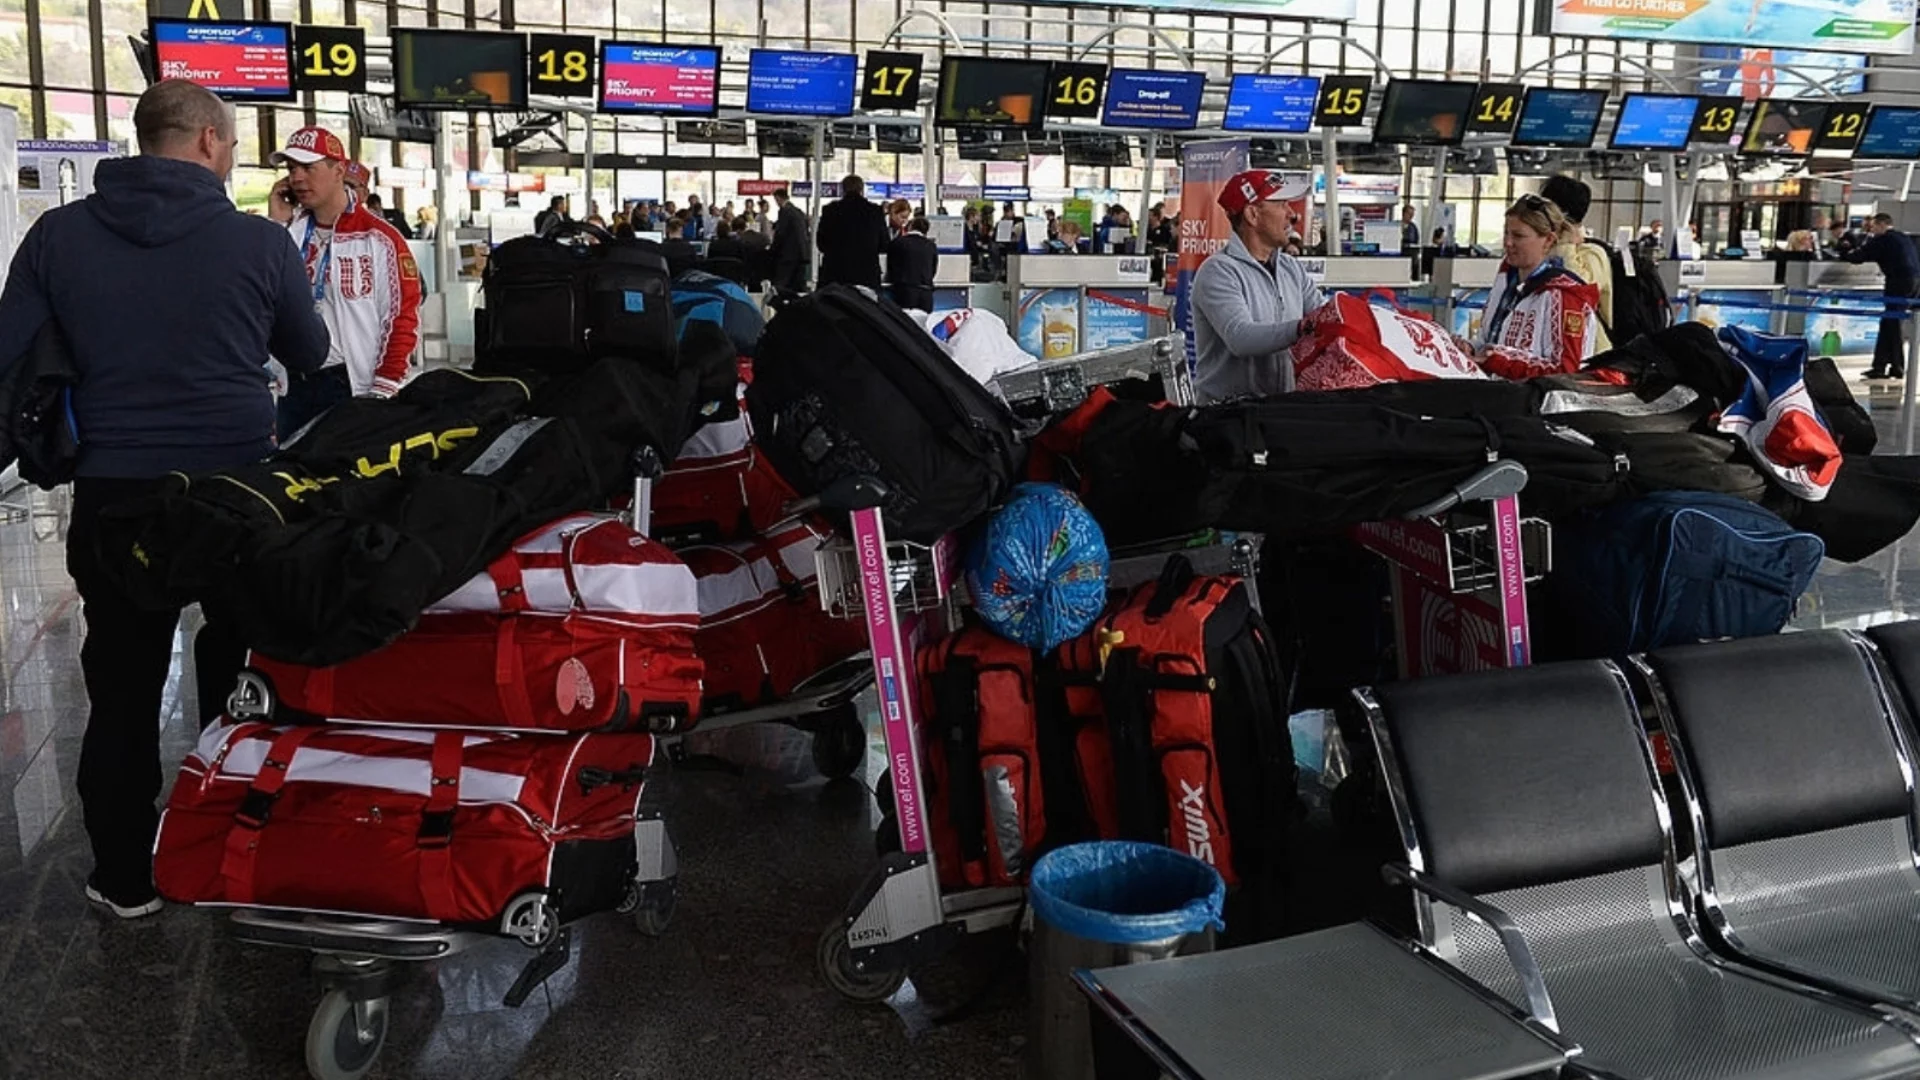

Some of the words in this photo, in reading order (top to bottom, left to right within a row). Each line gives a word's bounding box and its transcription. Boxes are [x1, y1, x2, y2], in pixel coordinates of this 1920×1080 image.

[1615, 0, 1632, 9] GO
[1633, 0, 1686, 13] FURTHER
[162, 60, 188, 70] SKY
[305, 43, 356, 76] 19
[539, 50, 587, 81] 18
[162, 69, 221, 80] PRIORITY
[606, 79, 629, 88] SKY
[873, 68, 913, 96] 17
[606, 87, 656, 97] PRIORITY
[1056, 77, 1095, 104] 16
[1138, 90, 1171, 99] Drop-off
[1324, 89, 1363, 114] 15
[1479, 96, 1513, 120] 14
[1700, 108, 1734, 131] 13
[1829, 114, 1860, 136] 12
[287, 130, 318, 150] SSIA
[1182, 220, 1207, 236] SKY
[1181, 238, 1228, 255] PRIORI
[1502, 513, 1519, 598] www.ef.com
[863, 533, 886, 626] www.ef.com
[895, 752, 919, 842] www.ef.com
